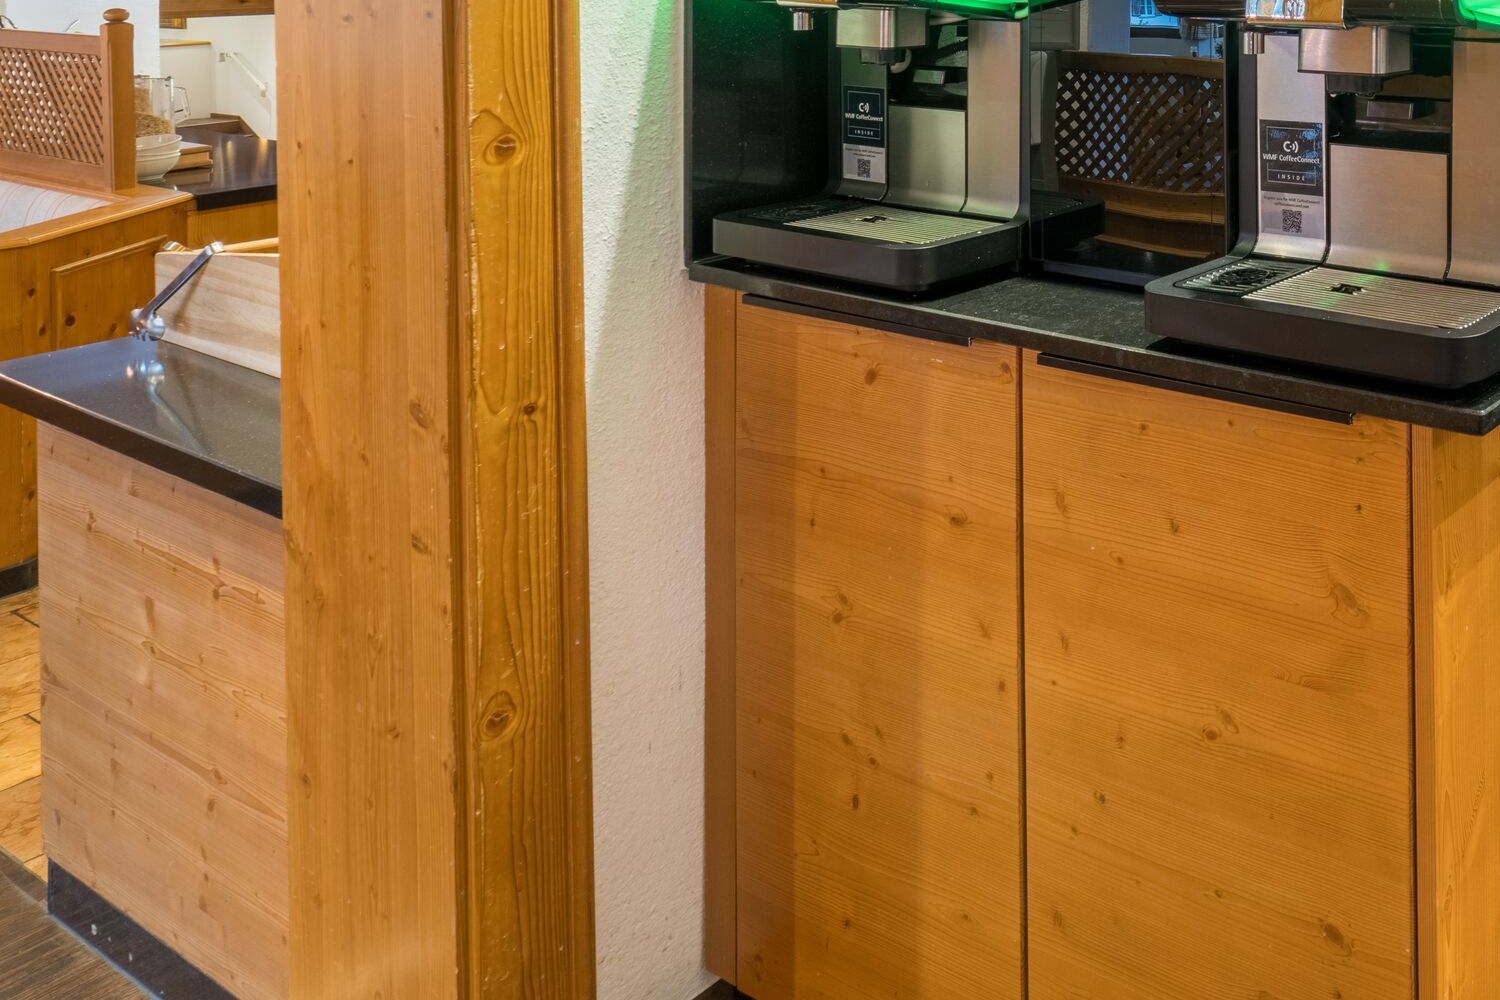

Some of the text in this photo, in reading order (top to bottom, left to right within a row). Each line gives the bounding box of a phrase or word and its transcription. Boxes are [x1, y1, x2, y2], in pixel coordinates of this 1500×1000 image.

[1262, 153, 1321, 164] WMF CoffeeConnect
[1277, 173, 1306, 181] INSIDE
